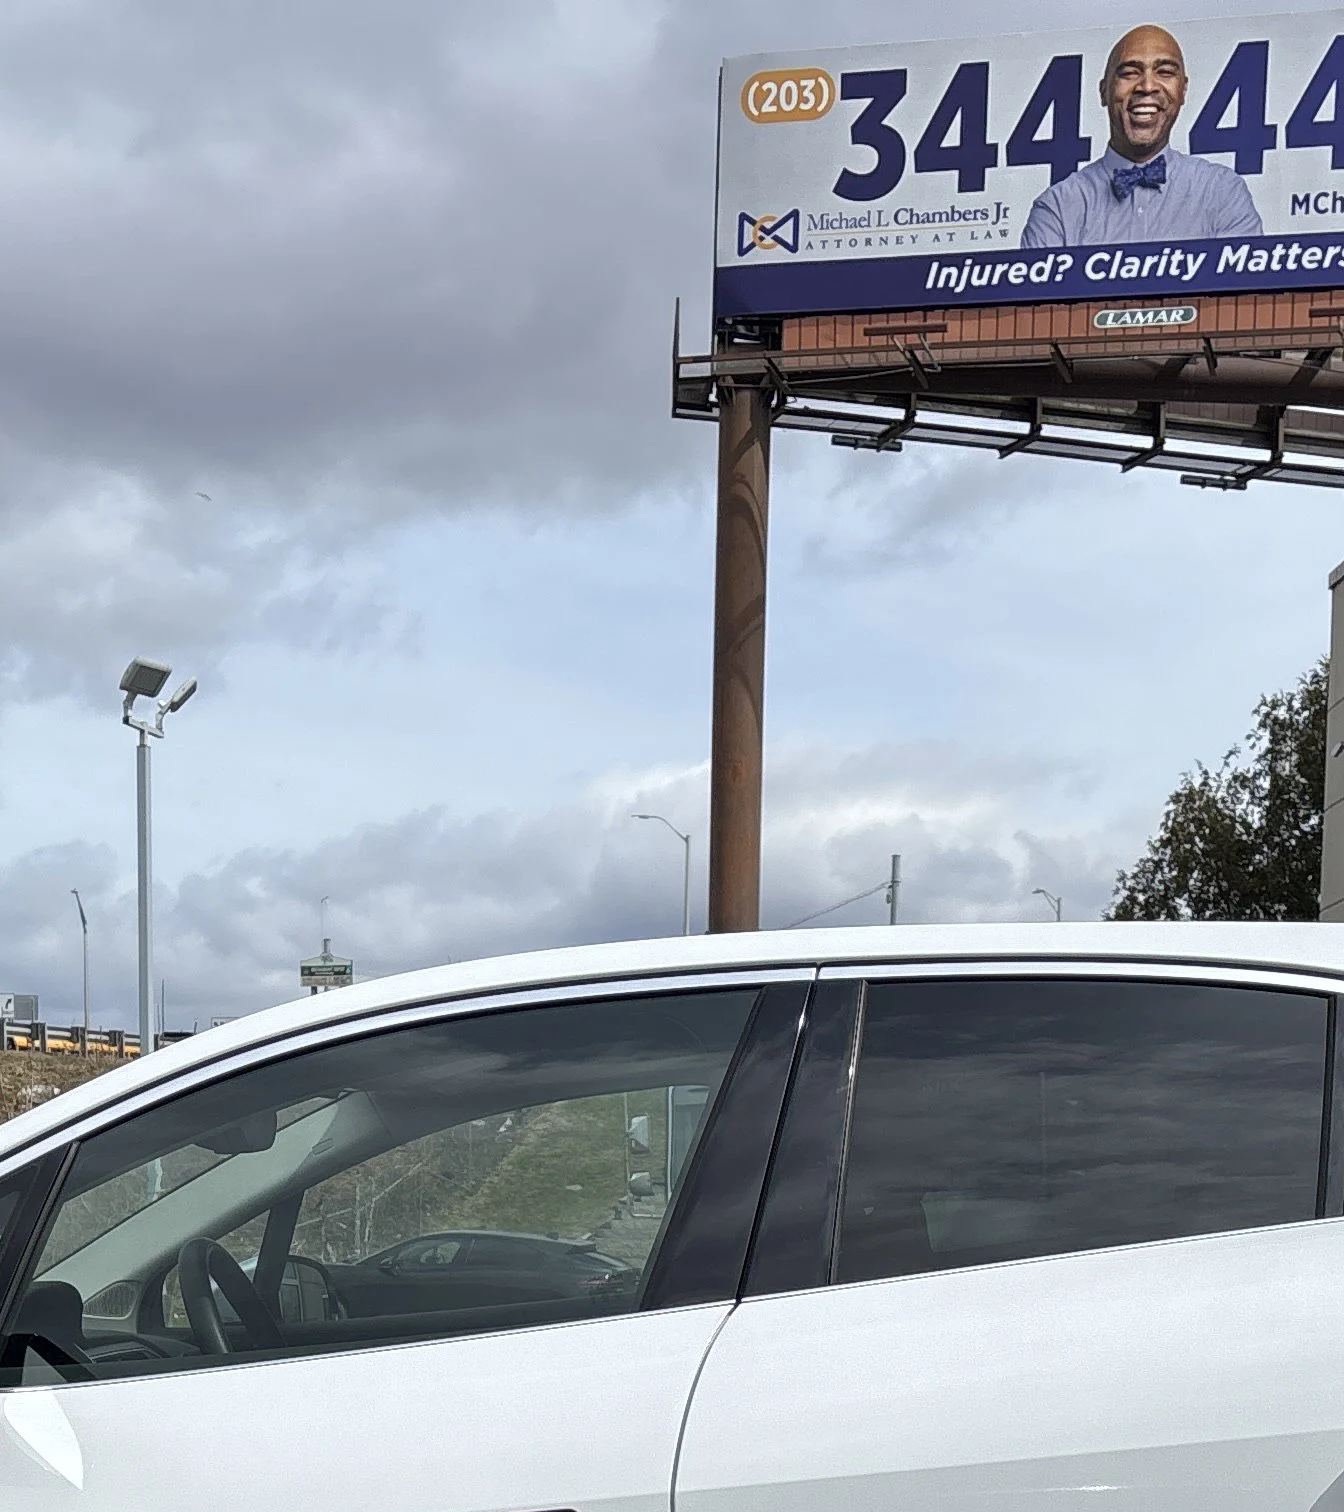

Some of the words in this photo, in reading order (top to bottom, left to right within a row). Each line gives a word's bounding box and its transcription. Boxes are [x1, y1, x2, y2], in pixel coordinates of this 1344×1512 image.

[747, 76, 829, 117] (203)
[831, 54, 1093, 202] 344
[806, 209, 871, 232] Michael
[876, 210, 889, 228] L
[893, 204, 989, 226] Chambers
[992, 201, 1010, 225] Jr
[805, 233, 919, 250] ATTORNEY
[932, 231, 957, 243] AT
[970, 228, 1010, 241] LAW
[925, 253, 1074, 293] Injured?
[1084, 247, 1207, 281] Clarity
[1104, 308, 1187, 326] LAMAR
